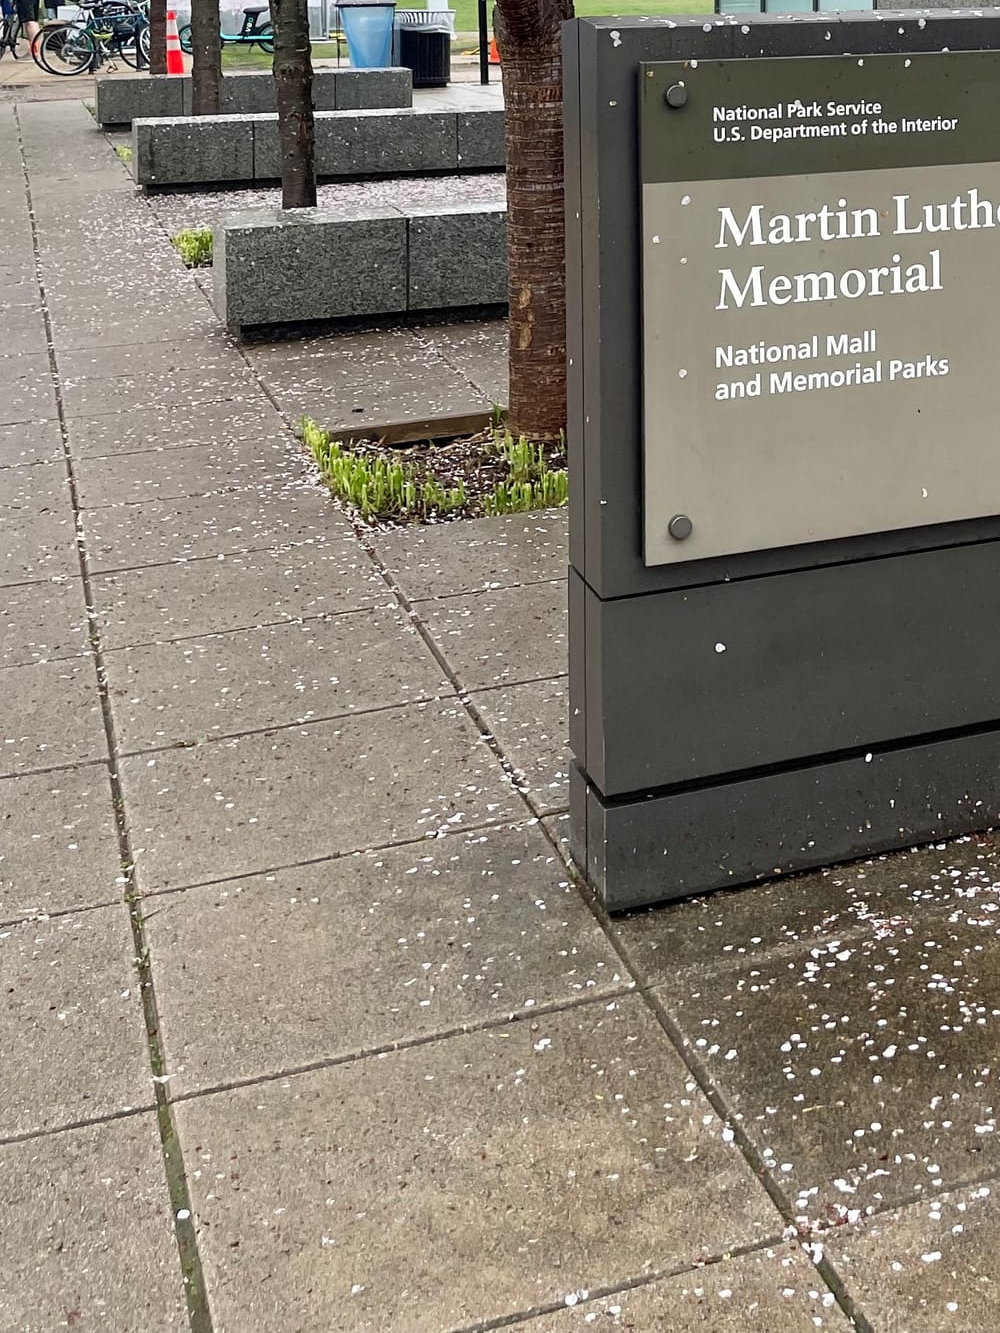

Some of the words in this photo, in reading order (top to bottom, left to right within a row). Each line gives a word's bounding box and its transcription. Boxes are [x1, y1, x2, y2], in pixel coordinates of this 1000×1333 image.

[713, 102, 783, 122] National
[787, 102, 823, 119] Park
[826, 100, 882, 116] Service
[713, 126, 746, 142] U.S.
[750, 122, 848, 143] Department
[850, 119, 868, 135] of
[871, 118, 898, 134] the
[901, 115, 958, 133] Interior
[714, 198, 881, 248] Martin
[715, 249, 944, 310] Memorial
[715, 335, 818, 368] National
[826, 329, 876, 357] Mall
[715, 373, 761, 400] and
[770, 360, 882, 394] Memorial
[889, 354, 949, 381] Parks
